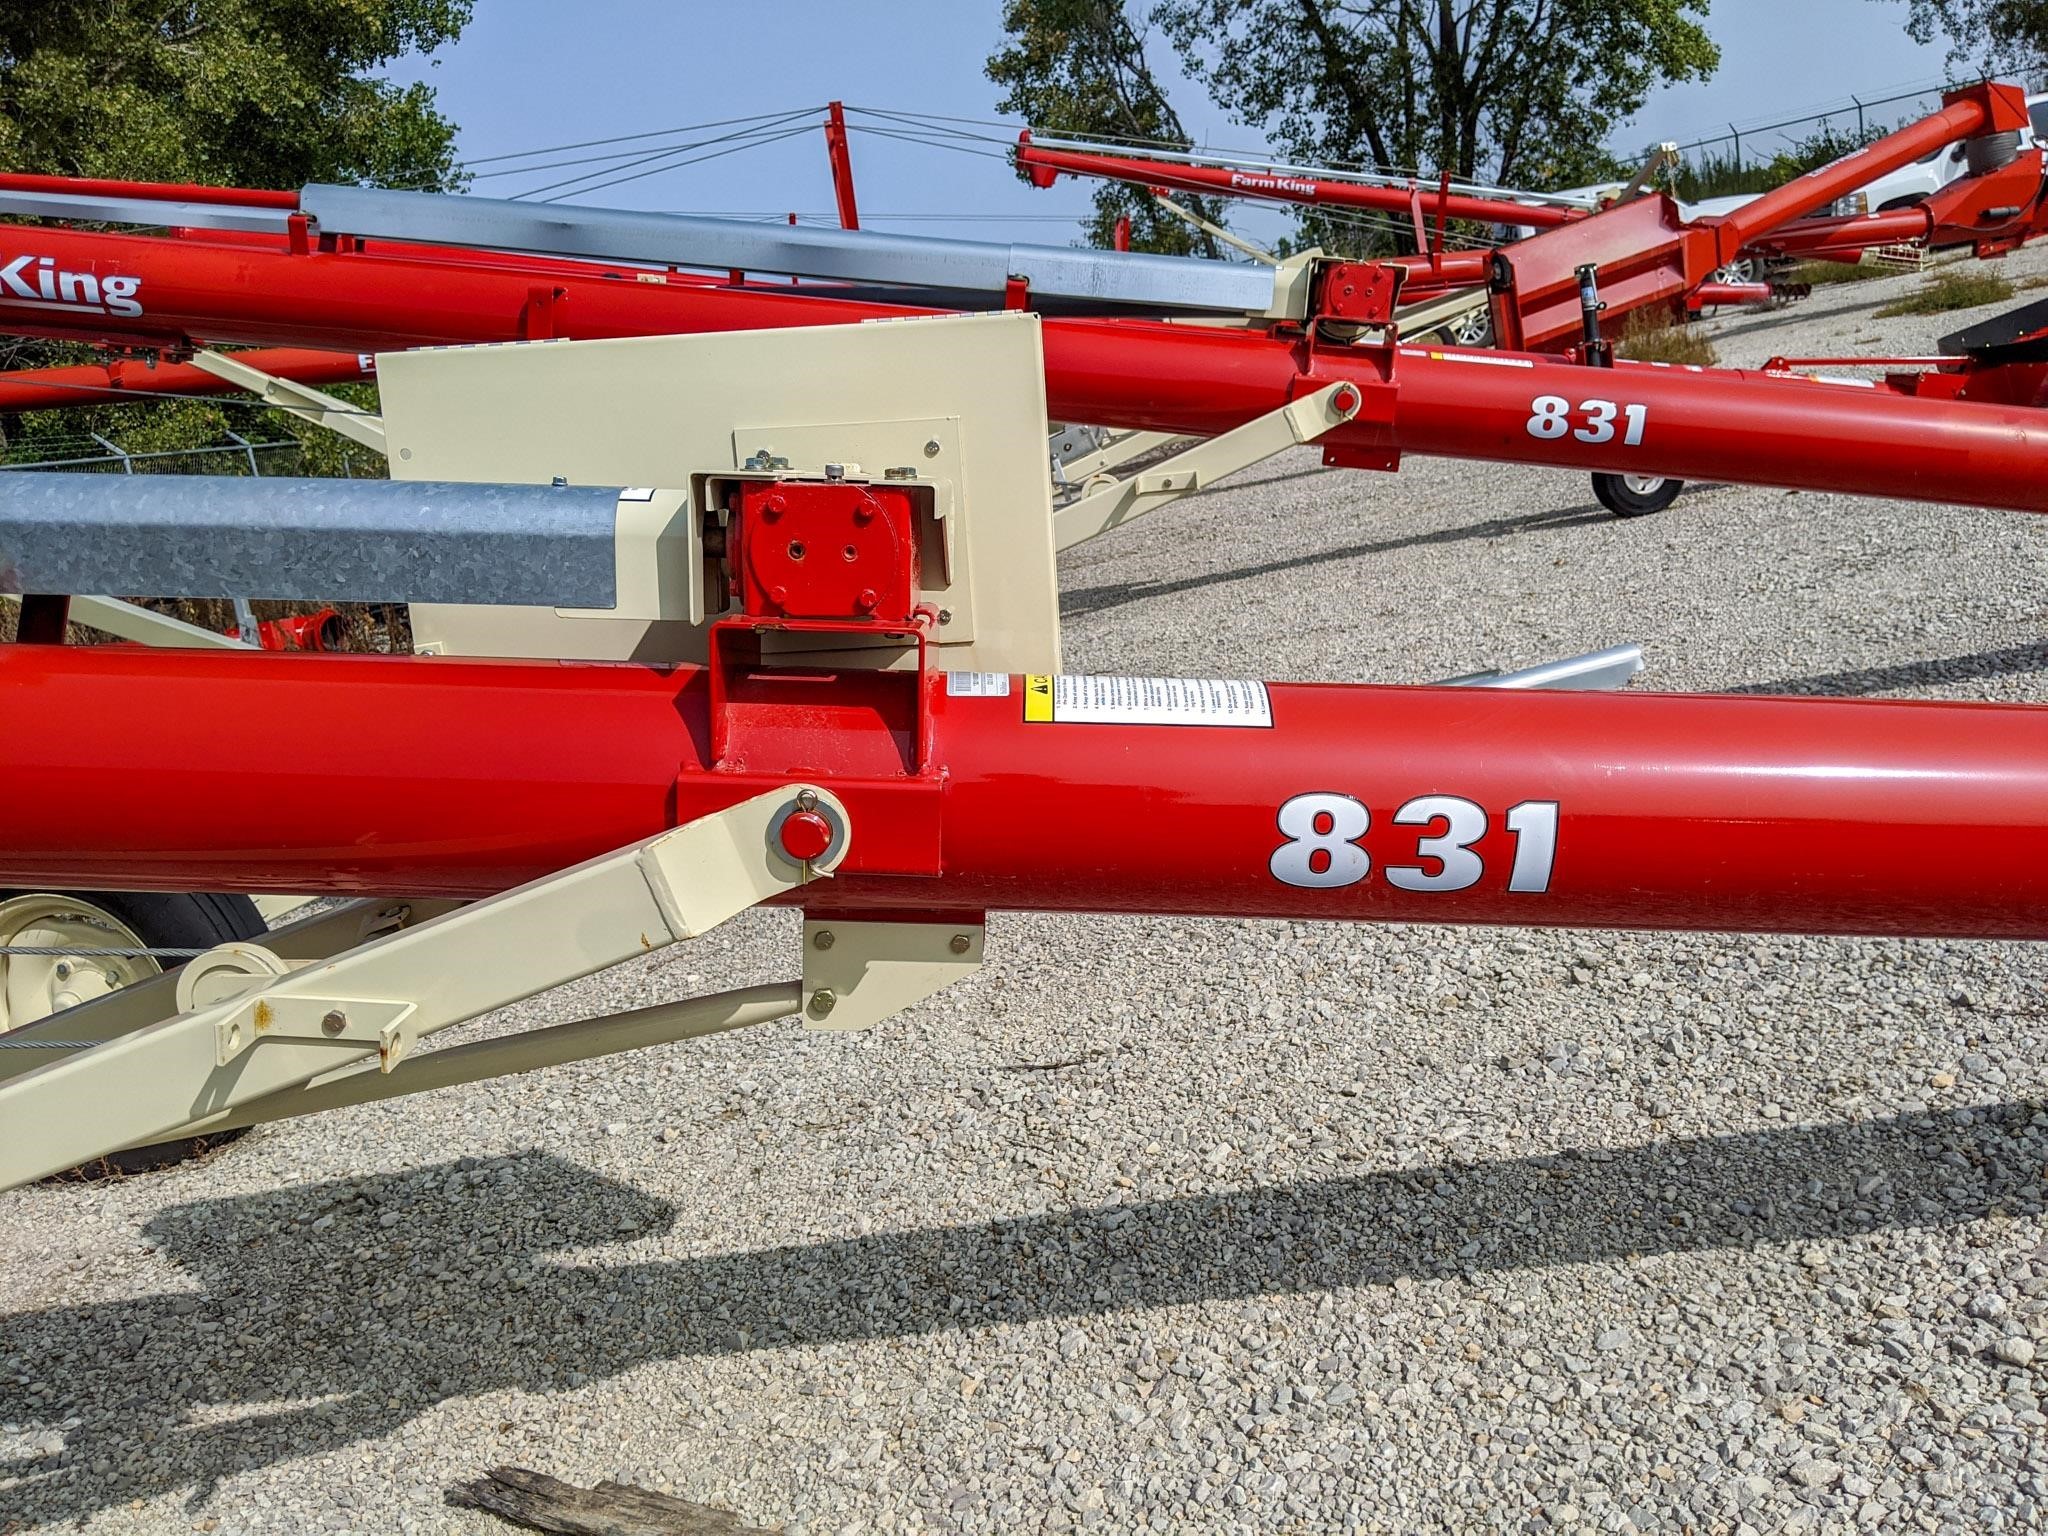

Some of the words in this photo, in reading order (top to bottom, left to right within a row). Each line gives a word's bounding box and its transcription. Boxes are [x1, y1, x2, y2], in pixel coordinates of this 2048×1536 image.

[1231, 173, 1275, 189] Farm
[1277, 178, 1317, 196] King
[0, 254, 144, 318] King
[1525, 394, 1649, 447] 831
[1268, 790, 1560, 894] 831
